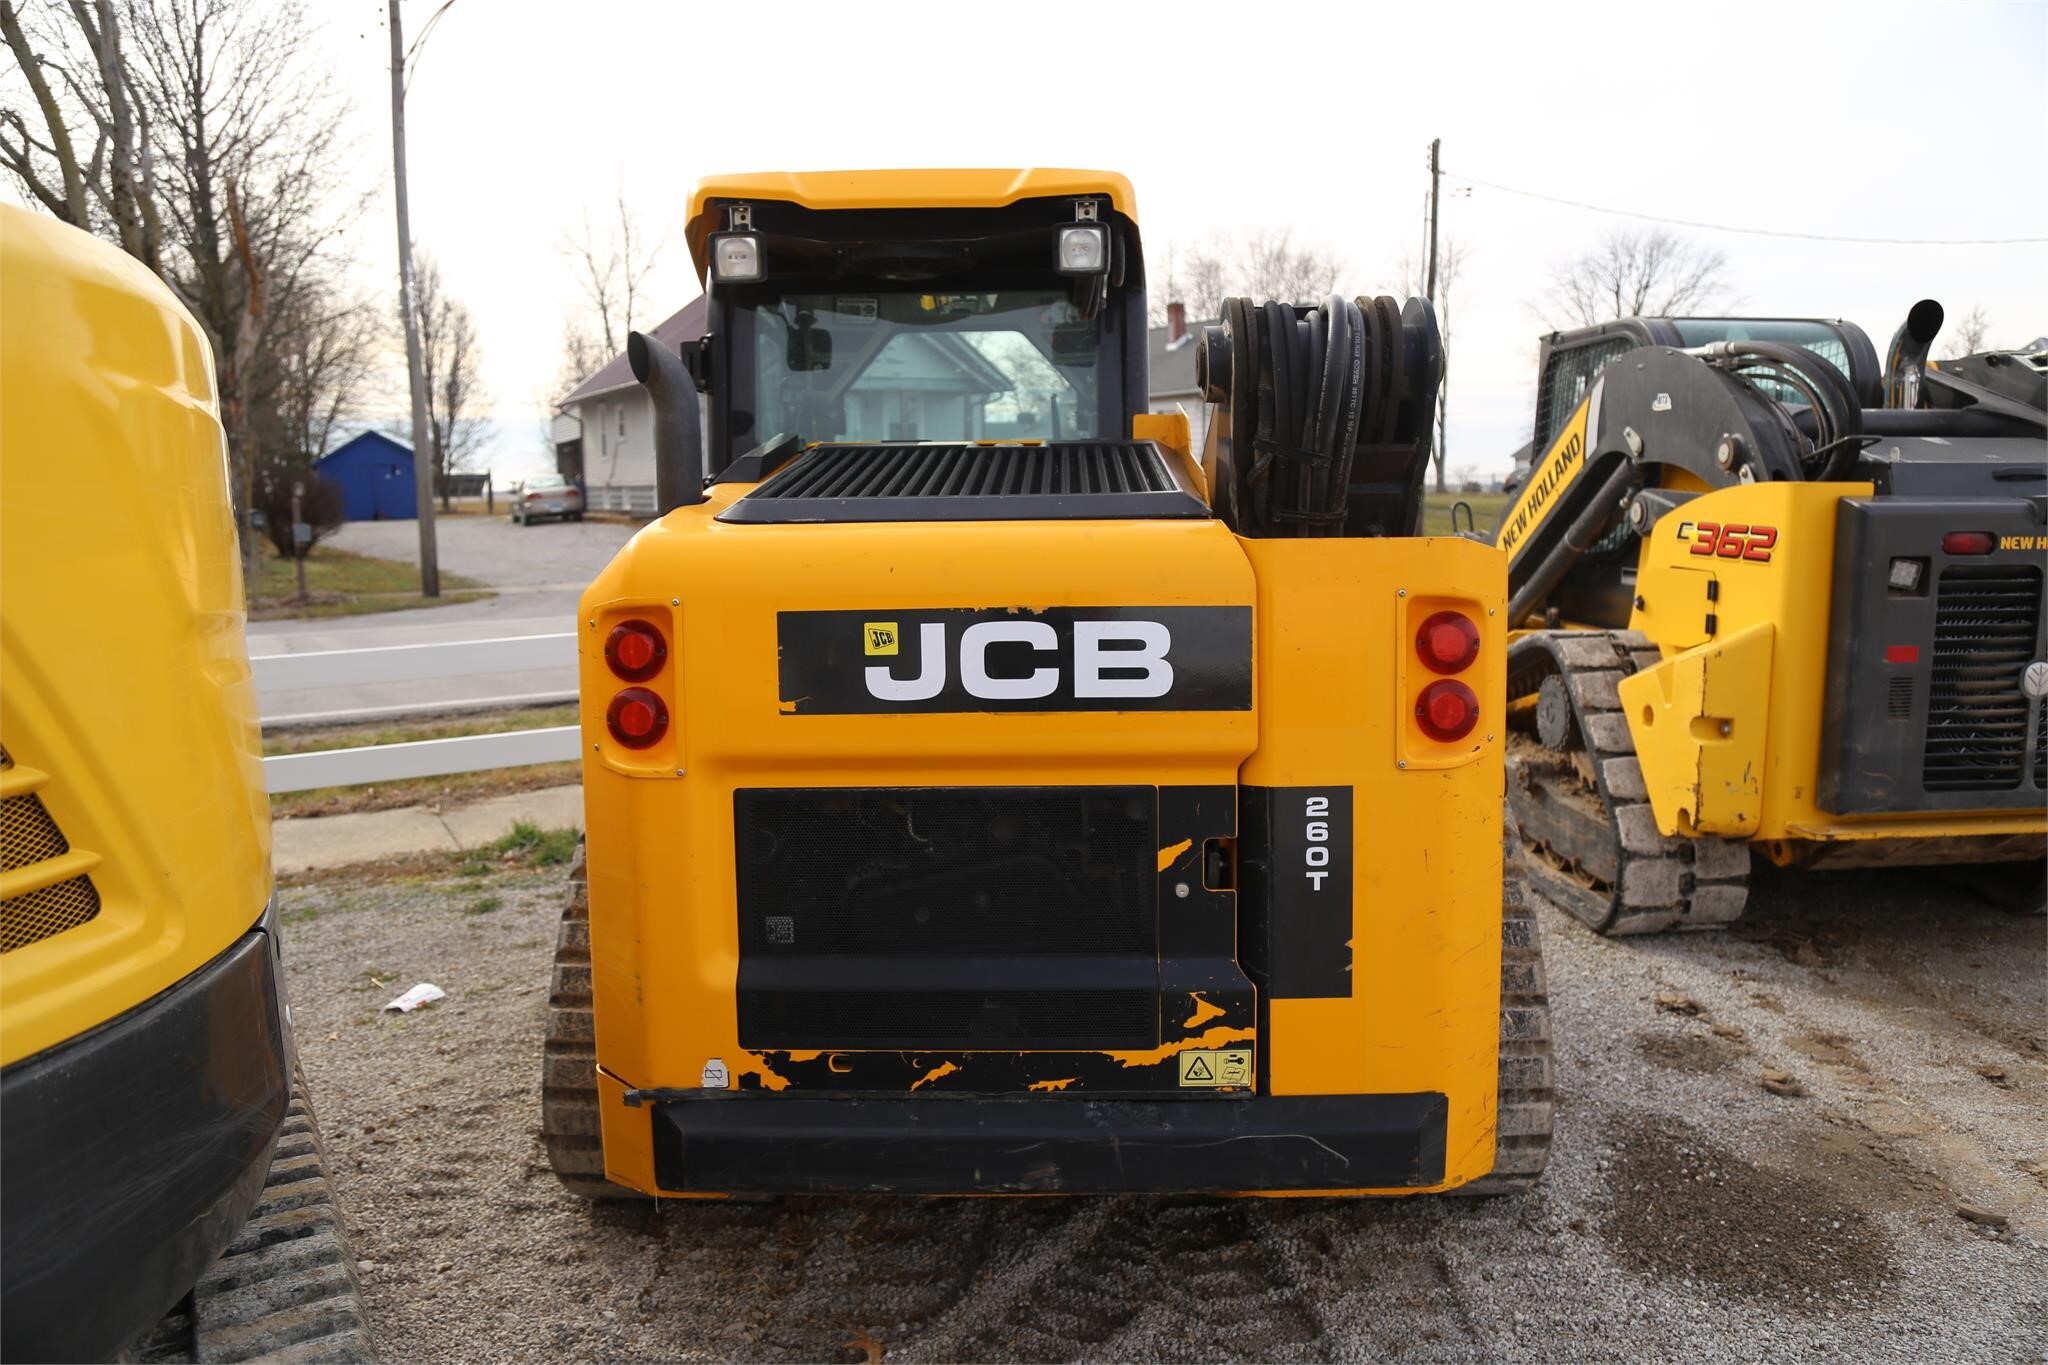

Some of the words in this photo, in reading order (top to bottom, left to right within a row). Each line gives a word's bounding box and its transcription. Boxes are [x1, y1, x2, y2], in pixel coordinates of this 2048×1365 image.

[1503, 507, 1528, 552] NEW
[1527, 433, 1581, 519] HOLLAND
[1677, 521, 1779, 563] C362
[2000, 536, 2034, 550] NEW
[865, 621, 1174, 701] JCB
[873, 631, 893, 648] JCB
[1305, 796, 1329, 891] 260T
